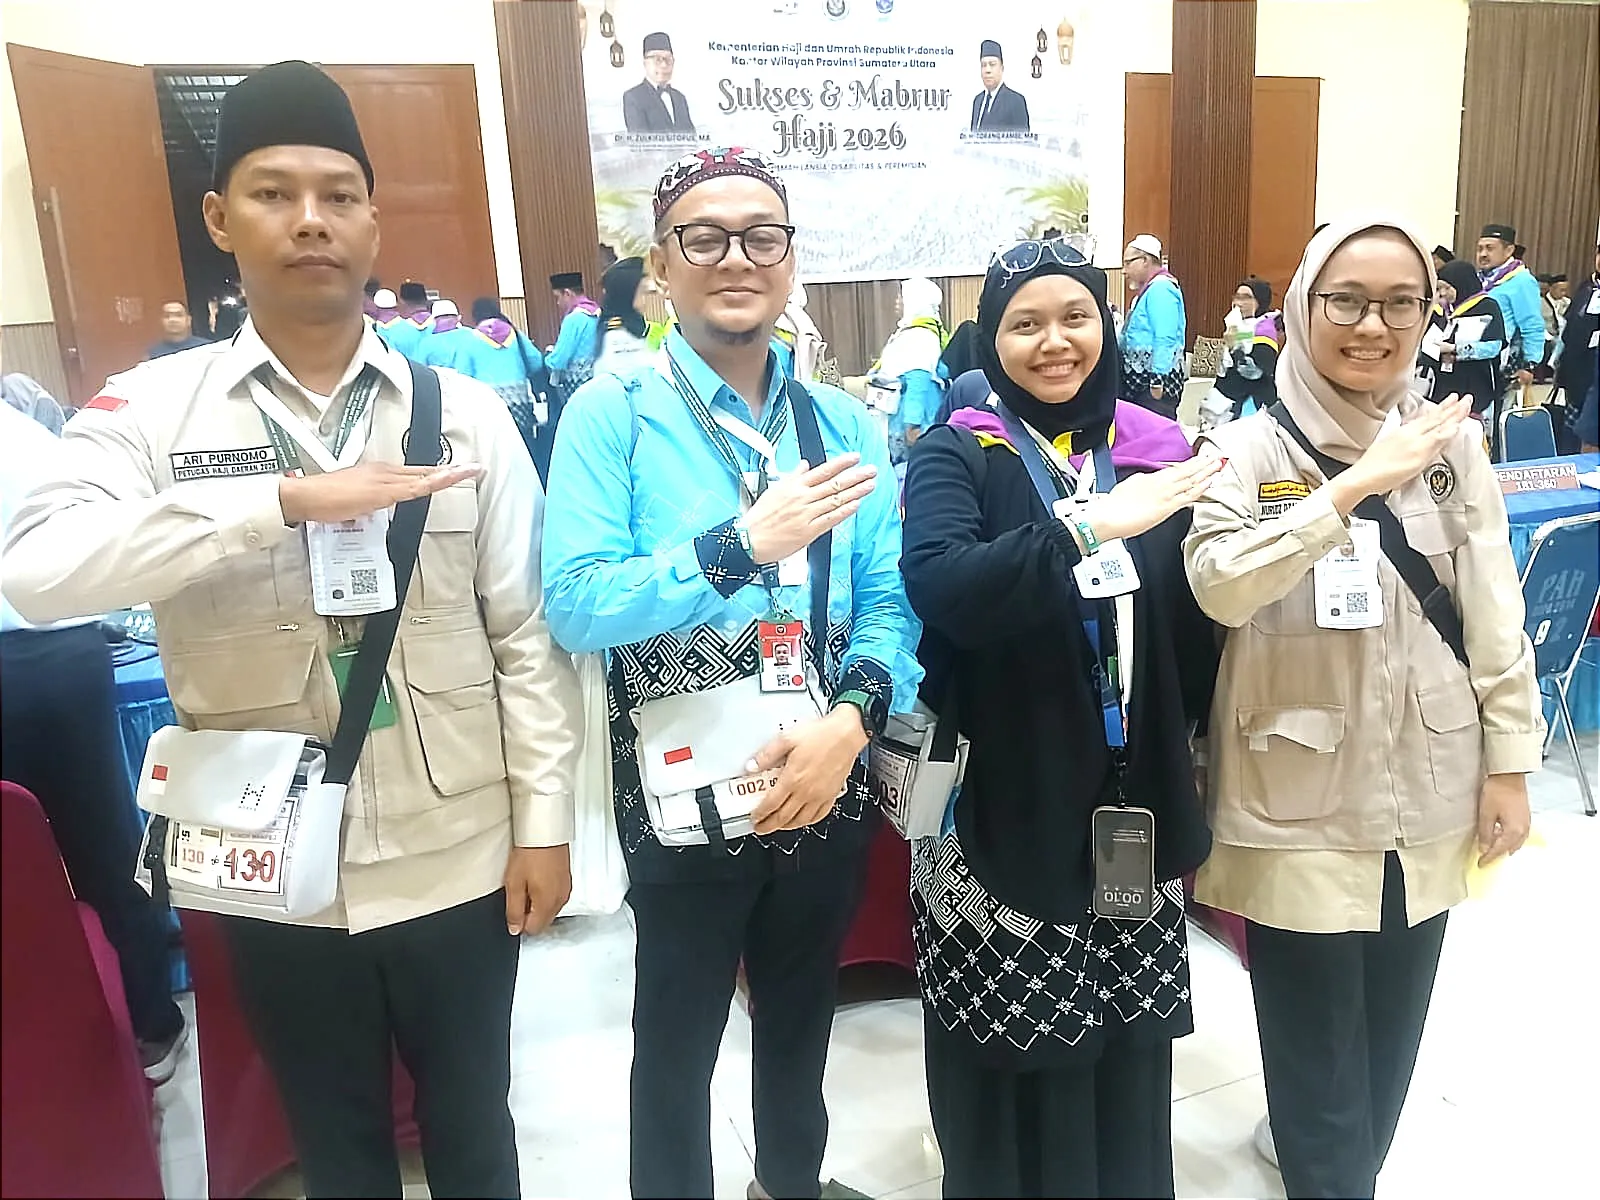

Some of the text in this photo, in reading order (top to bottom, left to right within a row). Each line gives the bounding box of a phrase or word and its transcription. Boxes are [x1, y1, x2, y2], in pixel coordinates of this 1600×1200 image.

[782, 42, 802, 55] Haji
[804, 44, 824, 53] dan
[826, 45, 861, 54] Umrah
[863, 45, 905, 56] Republik
[907, 46, 954, 55] Indonesia
[770, 56, 814, 69] Wilayah
[816, 57, 857, 67] Provinsi
[859, 58, 908, 68] Sumatera
[909, 59, 936, 68] Utara
[718, 74, 952, 115] Sukses & Mabrur
[773, 114, 907, 158] Haji 2026
[183, 450, 267, 466] ARI PURNOMO
[178, 461, 276, 478] PETUGAS HAJI DAERAH 2026
[736, 779, 767, 796] 002
[181, 847, 276, 883] 130 130
